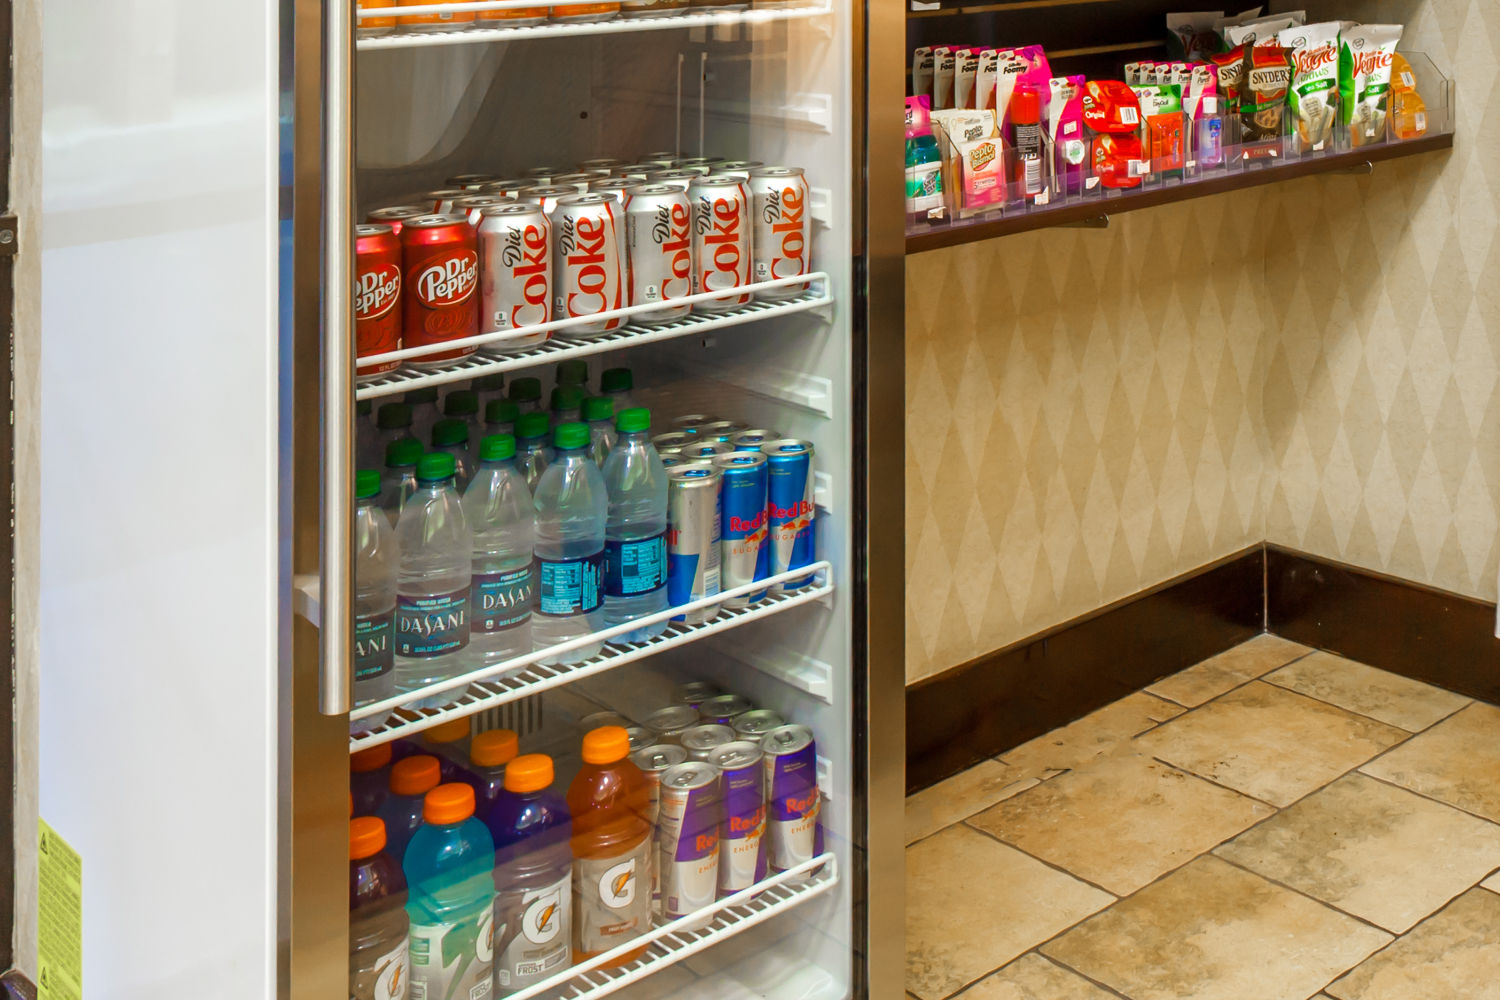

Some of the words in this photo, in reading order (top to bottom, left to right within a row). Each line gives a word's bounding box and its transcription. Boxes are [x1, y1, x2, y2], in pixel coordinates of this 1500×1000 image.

[1003, 65, 1027, 75] Foamy
[1292, 47, 1337, 78] Veggie
[1352, 50, 1393, 79] Veggie
[652, 204, 669, 244] Diet
[696, 195, 711, 236] Diet
[763, 187, 780, 225] Diet
[503, 226, 521, 268] Diet
[560, 215, 574, 256] Diet
[661, 203, 690, 302] Coke
[703, 195, 740, 293] Coke
[771, 186, 804, 282] Coke
[361, 271, 387, 292] Dr
[420, 264, 478, 303] Pepper
[447, 257, 469, 279] Dr
[512, 223, 548, 330] Coke
[567, 216, 607, 321] Coke
[730, 511, 761, 532] Red
[768, 501, 797, 518] Red
[400, 610, 464, 636] DASANI
[730, 807, 760, 832] Red
[786, 788, 814, 814] Red
